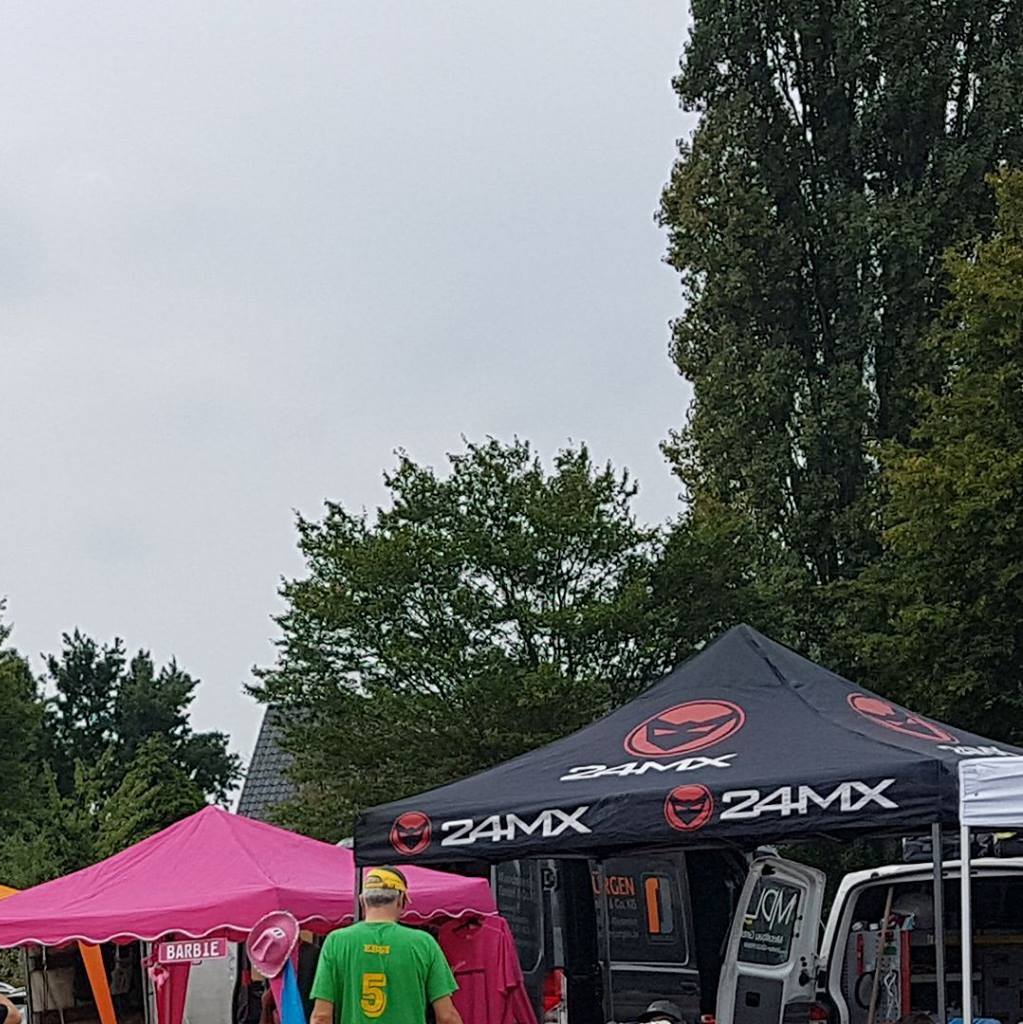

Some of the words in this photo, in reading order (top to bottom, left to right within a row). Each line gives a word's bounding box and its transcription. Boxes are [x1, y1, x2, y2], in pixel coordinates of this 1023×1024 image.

[559, 753, 738, 782] 24MX
[720, 778, 899, 821] 24MX
[441, 806, 592, 846] 24MX
[166, 941, 220, 960] BARBIE
[361, 973, 387, 1018] 5
